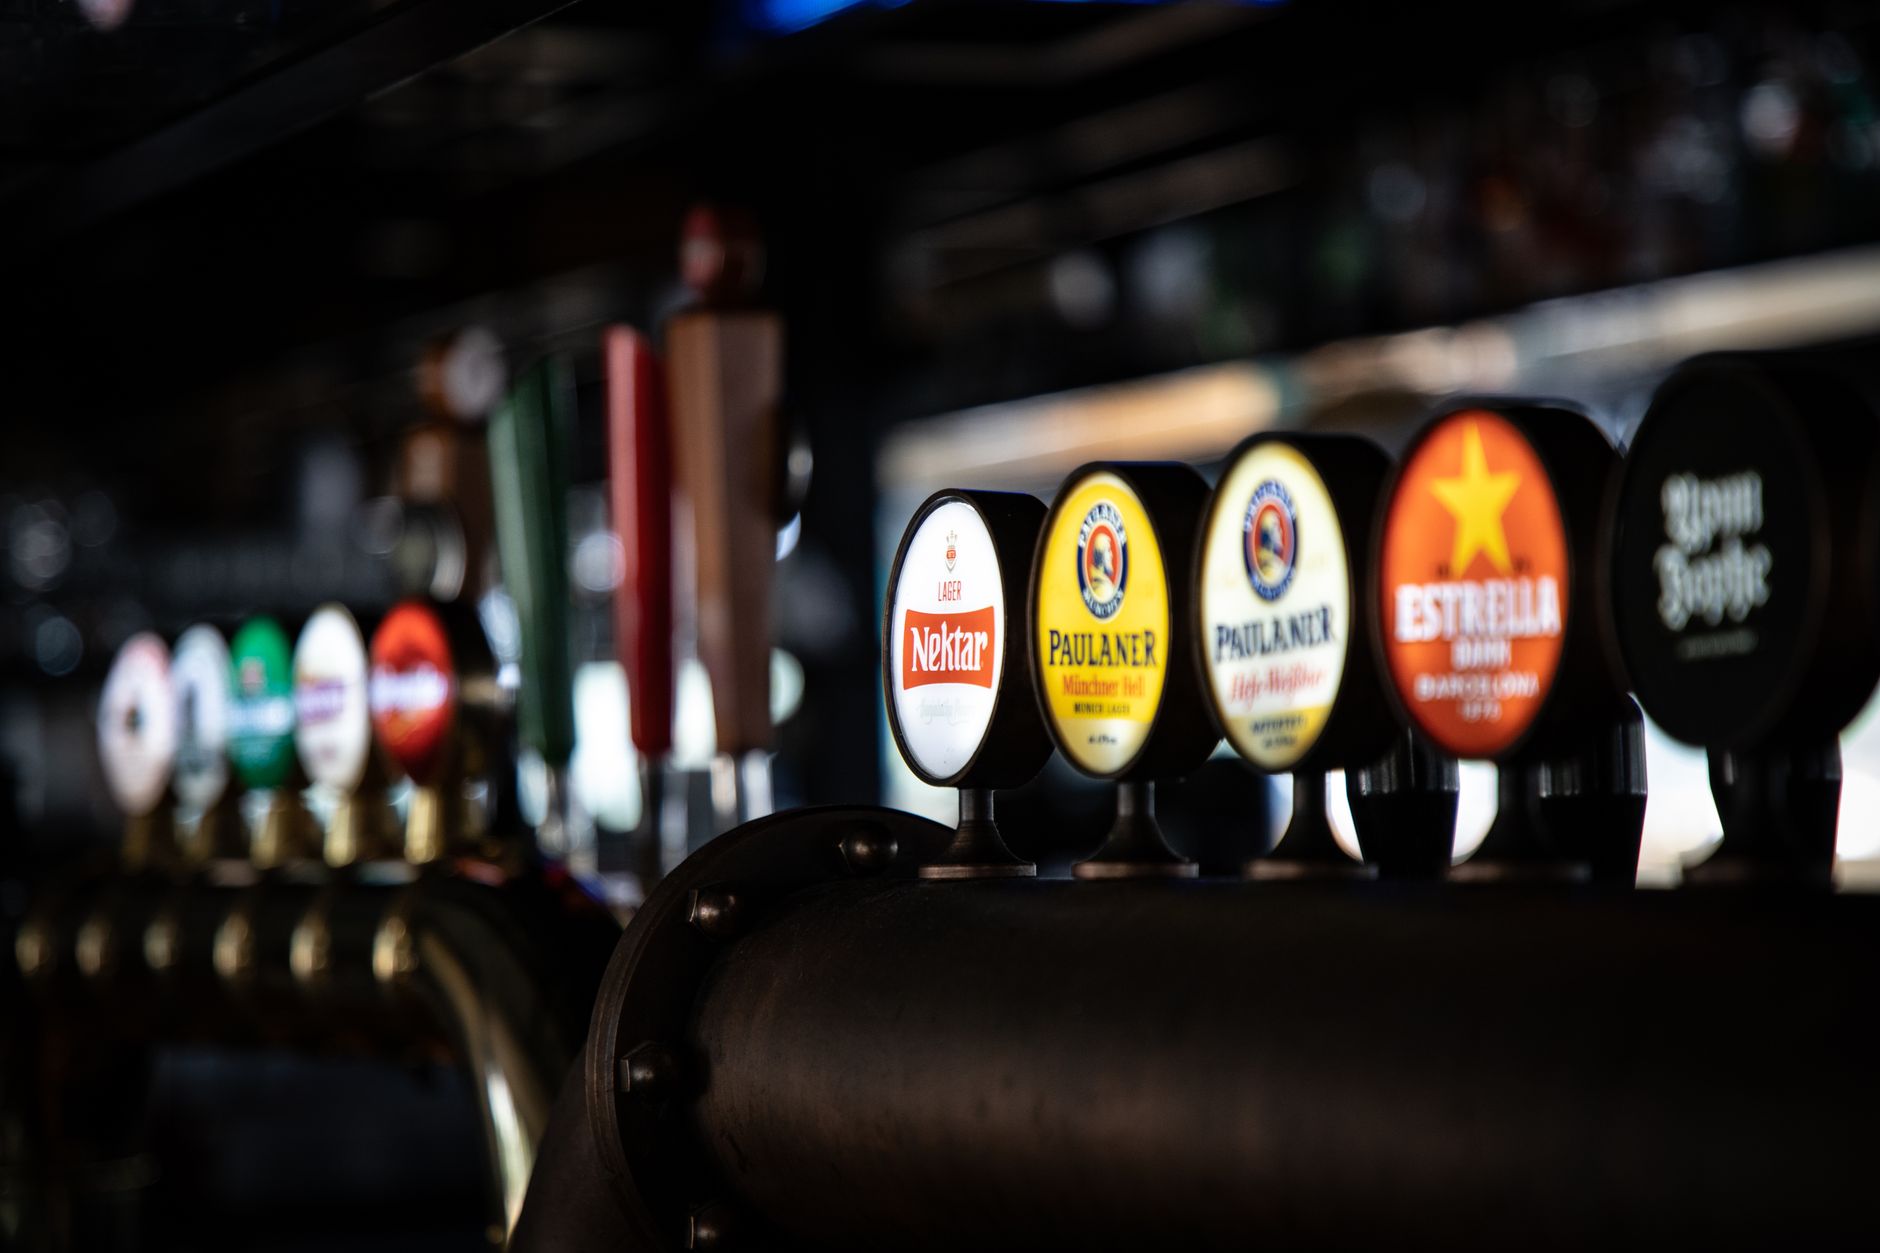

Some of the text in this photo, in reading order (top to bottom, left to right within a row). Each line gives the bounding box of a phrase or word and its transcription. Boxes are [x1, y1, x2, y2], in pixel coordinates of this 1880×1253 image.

[938, 580, 962, 602] LAGER
[1395, 575, 1561, 641] ESTRELLA
[911, 621, 988, 672] Nektar
[1048, 630, 1158, 667] PAULANER
[1214, 606, 1336, 663] PAULANER
